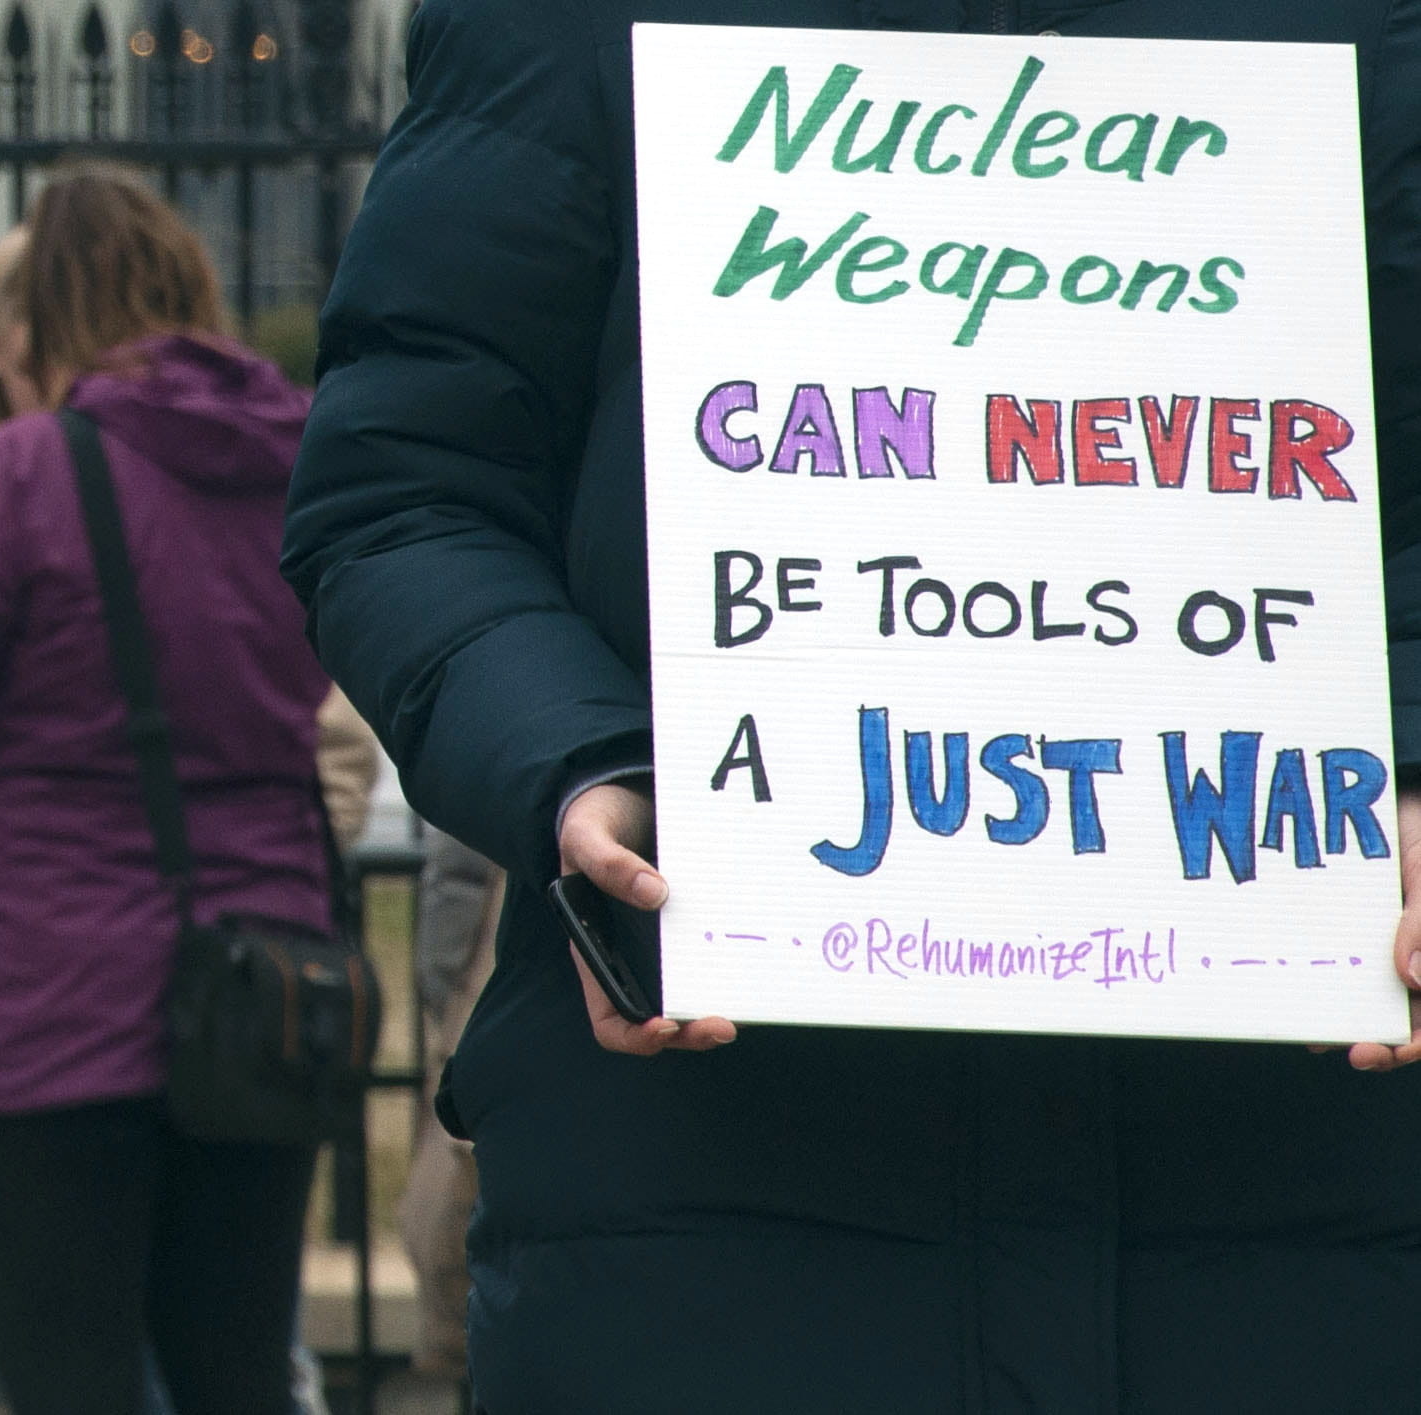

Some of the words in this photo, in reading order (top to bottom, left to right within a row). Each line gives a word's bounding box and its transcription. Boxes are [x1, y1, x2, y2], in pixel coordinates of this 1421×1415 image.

[717, 56, 1227, 181] Nuclear
[713, 206, 1244, 346] Weapons
[695, 380, 936, 480] CAN
[985, 394, 1357, 502] NEVER
[714, 550, 822, 648] BE
[857, 556, 1138, 646] TOOLS
[1177, 589, 1314, 662] OF
[711, 714, 772, 802] A
[810, 704, 1123, 876] JUST
[1158, 730, 1391, 885] WAR
[822, 917, 1176, 989] @RehumanizeIntl
